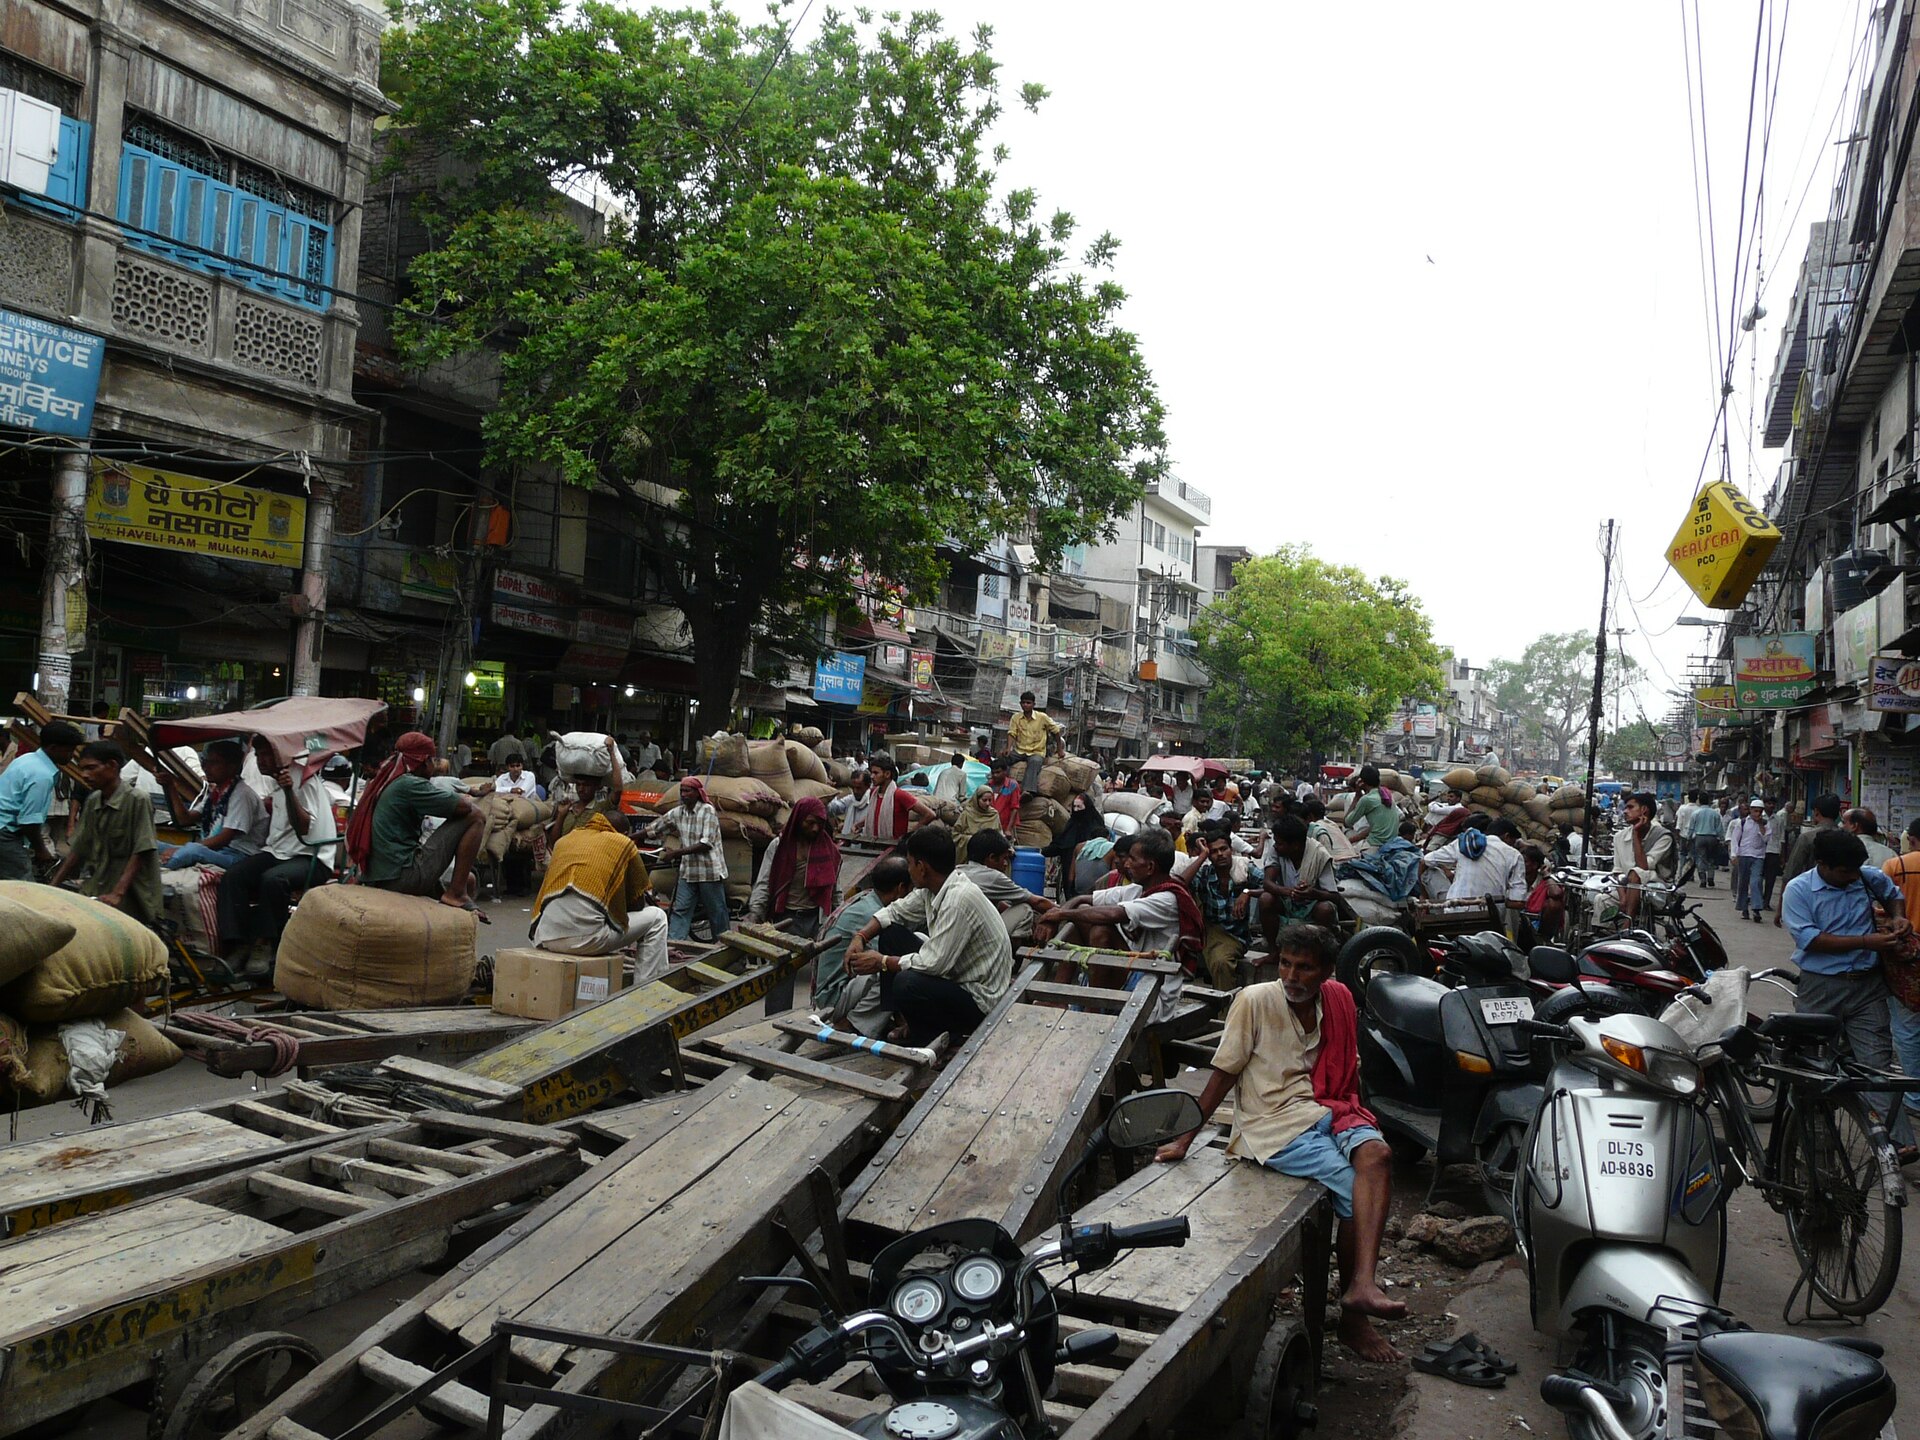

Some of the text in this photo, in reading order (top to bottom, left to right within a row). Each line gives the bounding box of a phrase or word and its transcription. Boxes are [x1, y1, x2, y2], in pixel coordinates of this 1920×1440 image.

[1721, 486, 1770, 530] PCO
[146, 507, 253, 542] नसवार
[1694, 512, 1712, 525] STD
[1694, 525, 1713, 537] ISD
[116, 525, 164, 543] HAVELI
[167, 534, 197, 548] RAM
[207, 540, 248, 556] MULKH
[251, 548, 276, 561] RAJ
[1697, 554, 1715, 567] PCO
[497, 575, 523, 593] GOPAL
[818, 673, 861, 692] गुलाब राय
[1608, 1141, 1644, 1156] DL-7S
[1600, 1161, 1654, 1177] AD-8836
